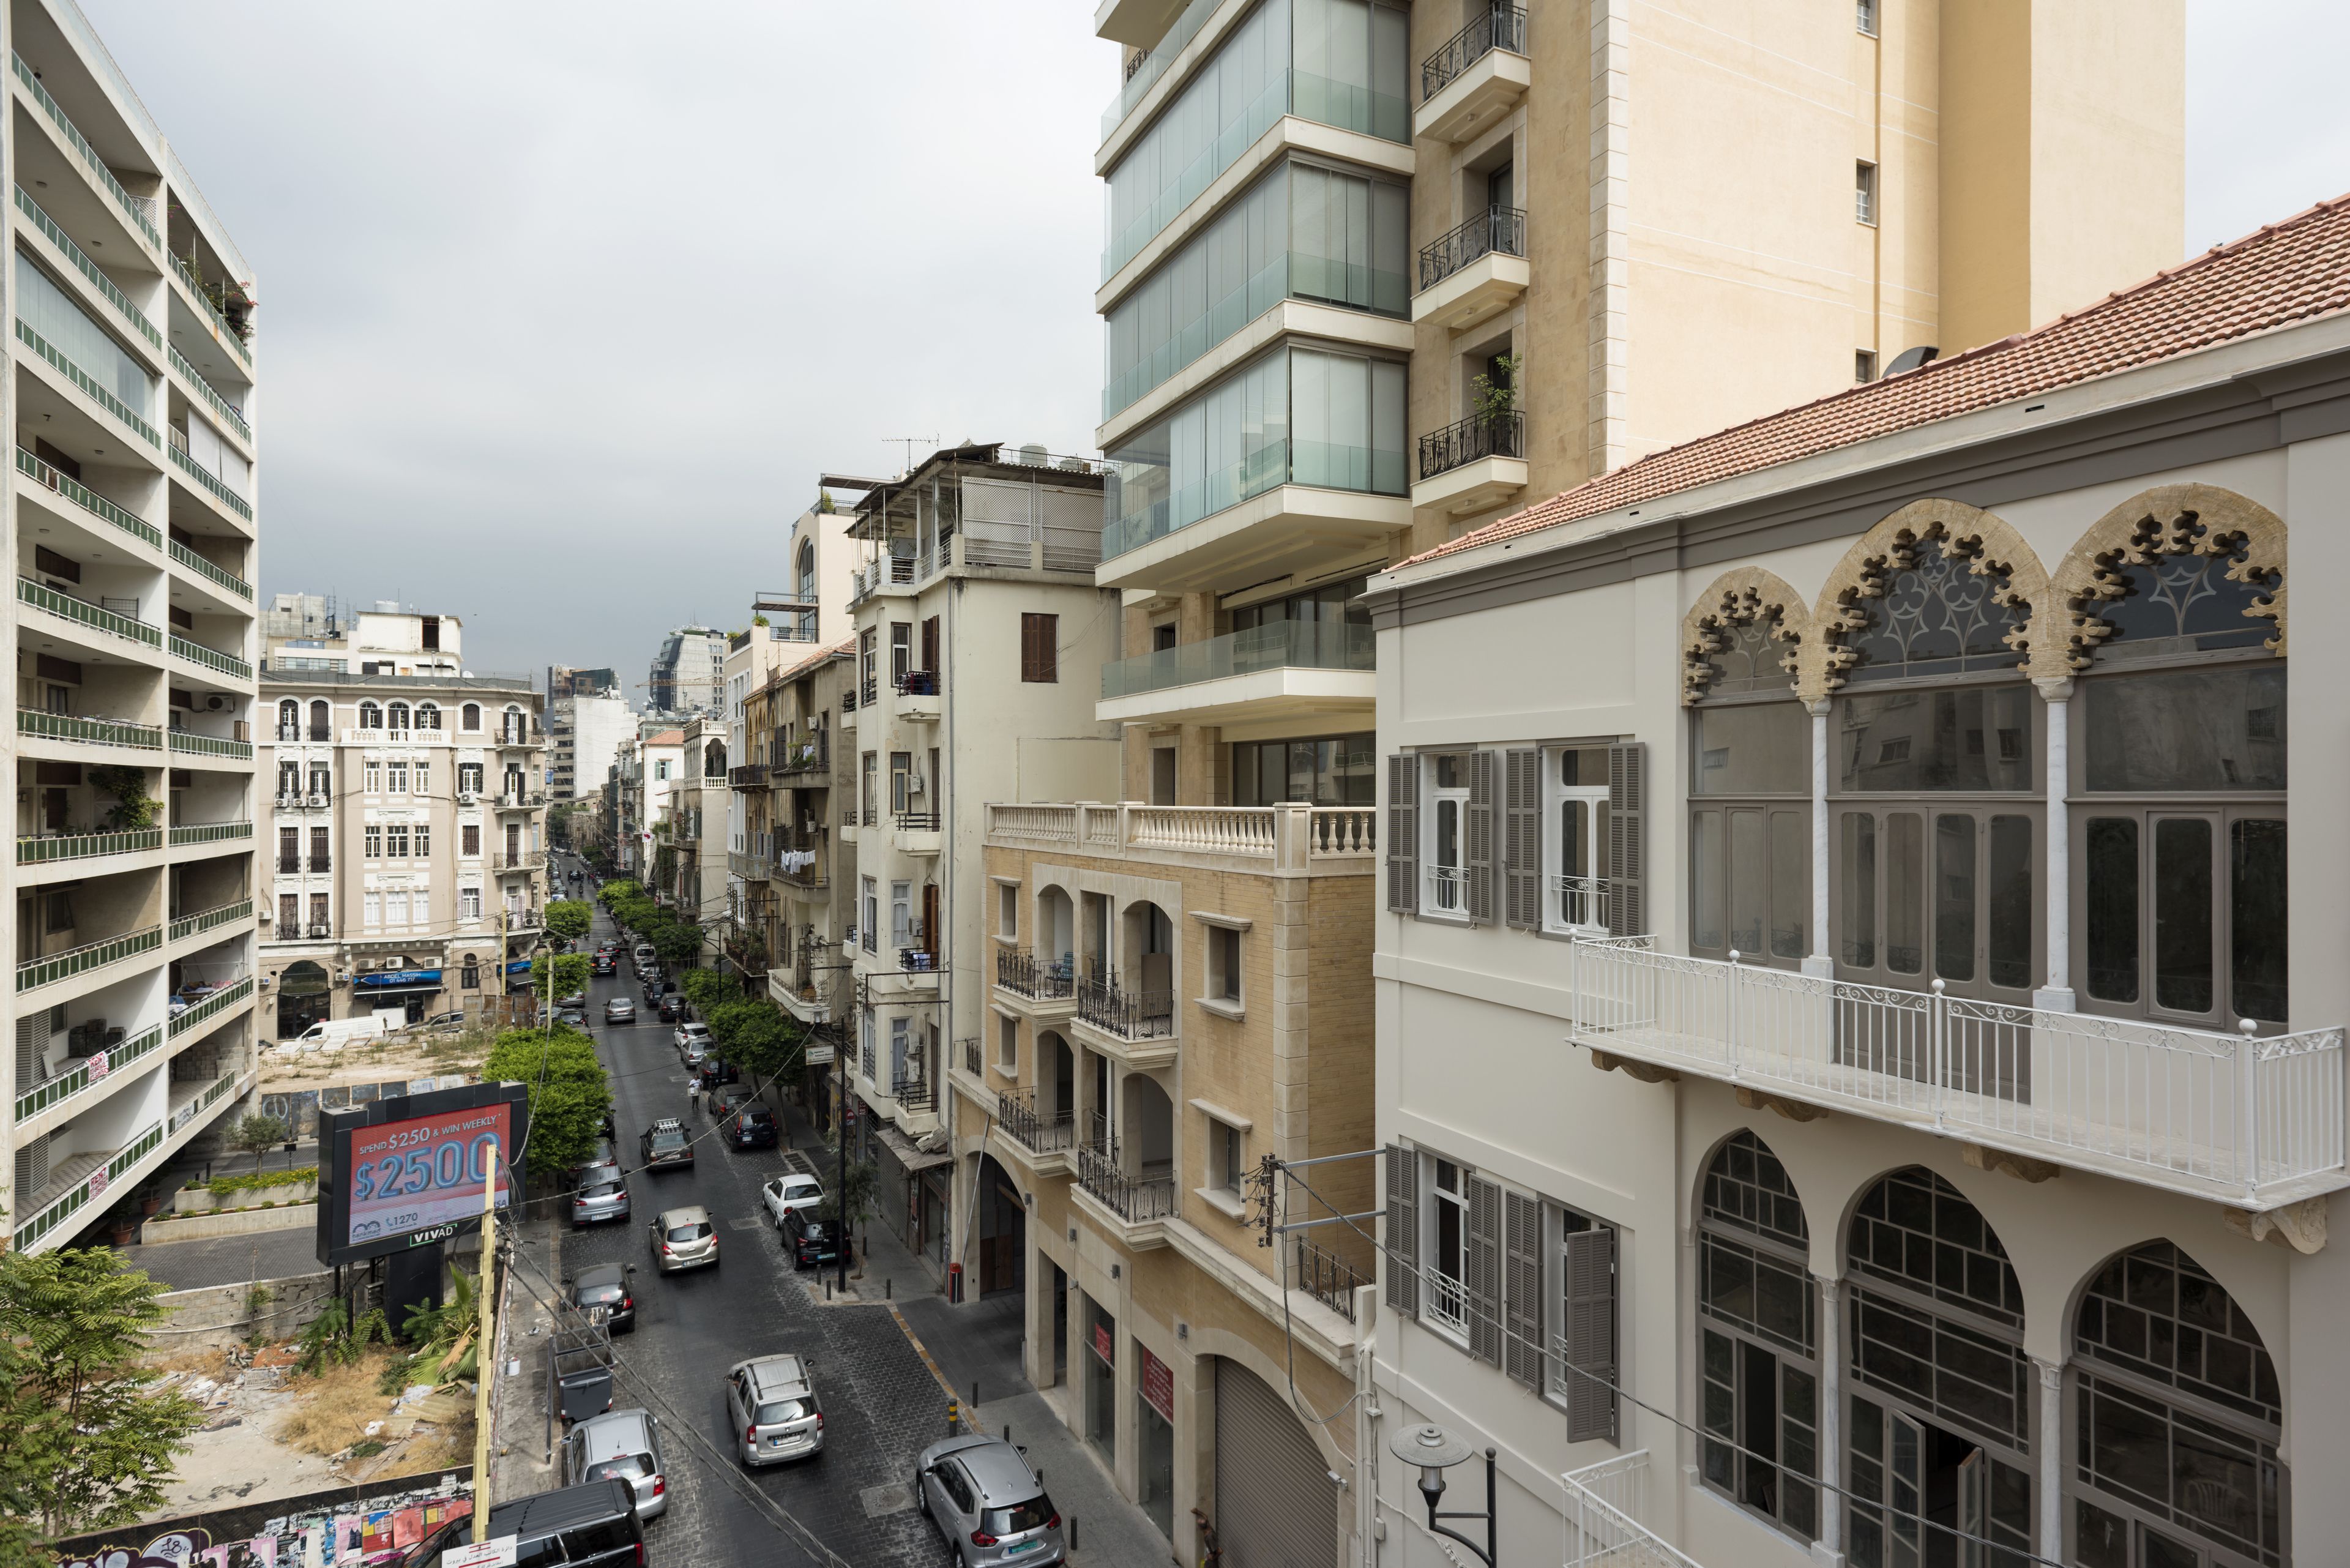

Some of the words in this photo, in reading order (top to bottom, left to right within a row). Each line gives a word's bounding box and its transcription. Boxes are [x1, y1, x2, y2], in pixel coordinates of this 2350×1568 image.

[88, 1052, 105, 1067] RENT
[359, 1141, 387, 1155] SPEND
[389, 1127, 430, 1151] $250
[433, 1129, 439, 1137] &
[442, 1124, 460, 1135] WIN
[354, 1131, 501, 1201] $2500
[90, 1167, 106, 1186] RENT
[394, 1212, 418, 1225] 1270
